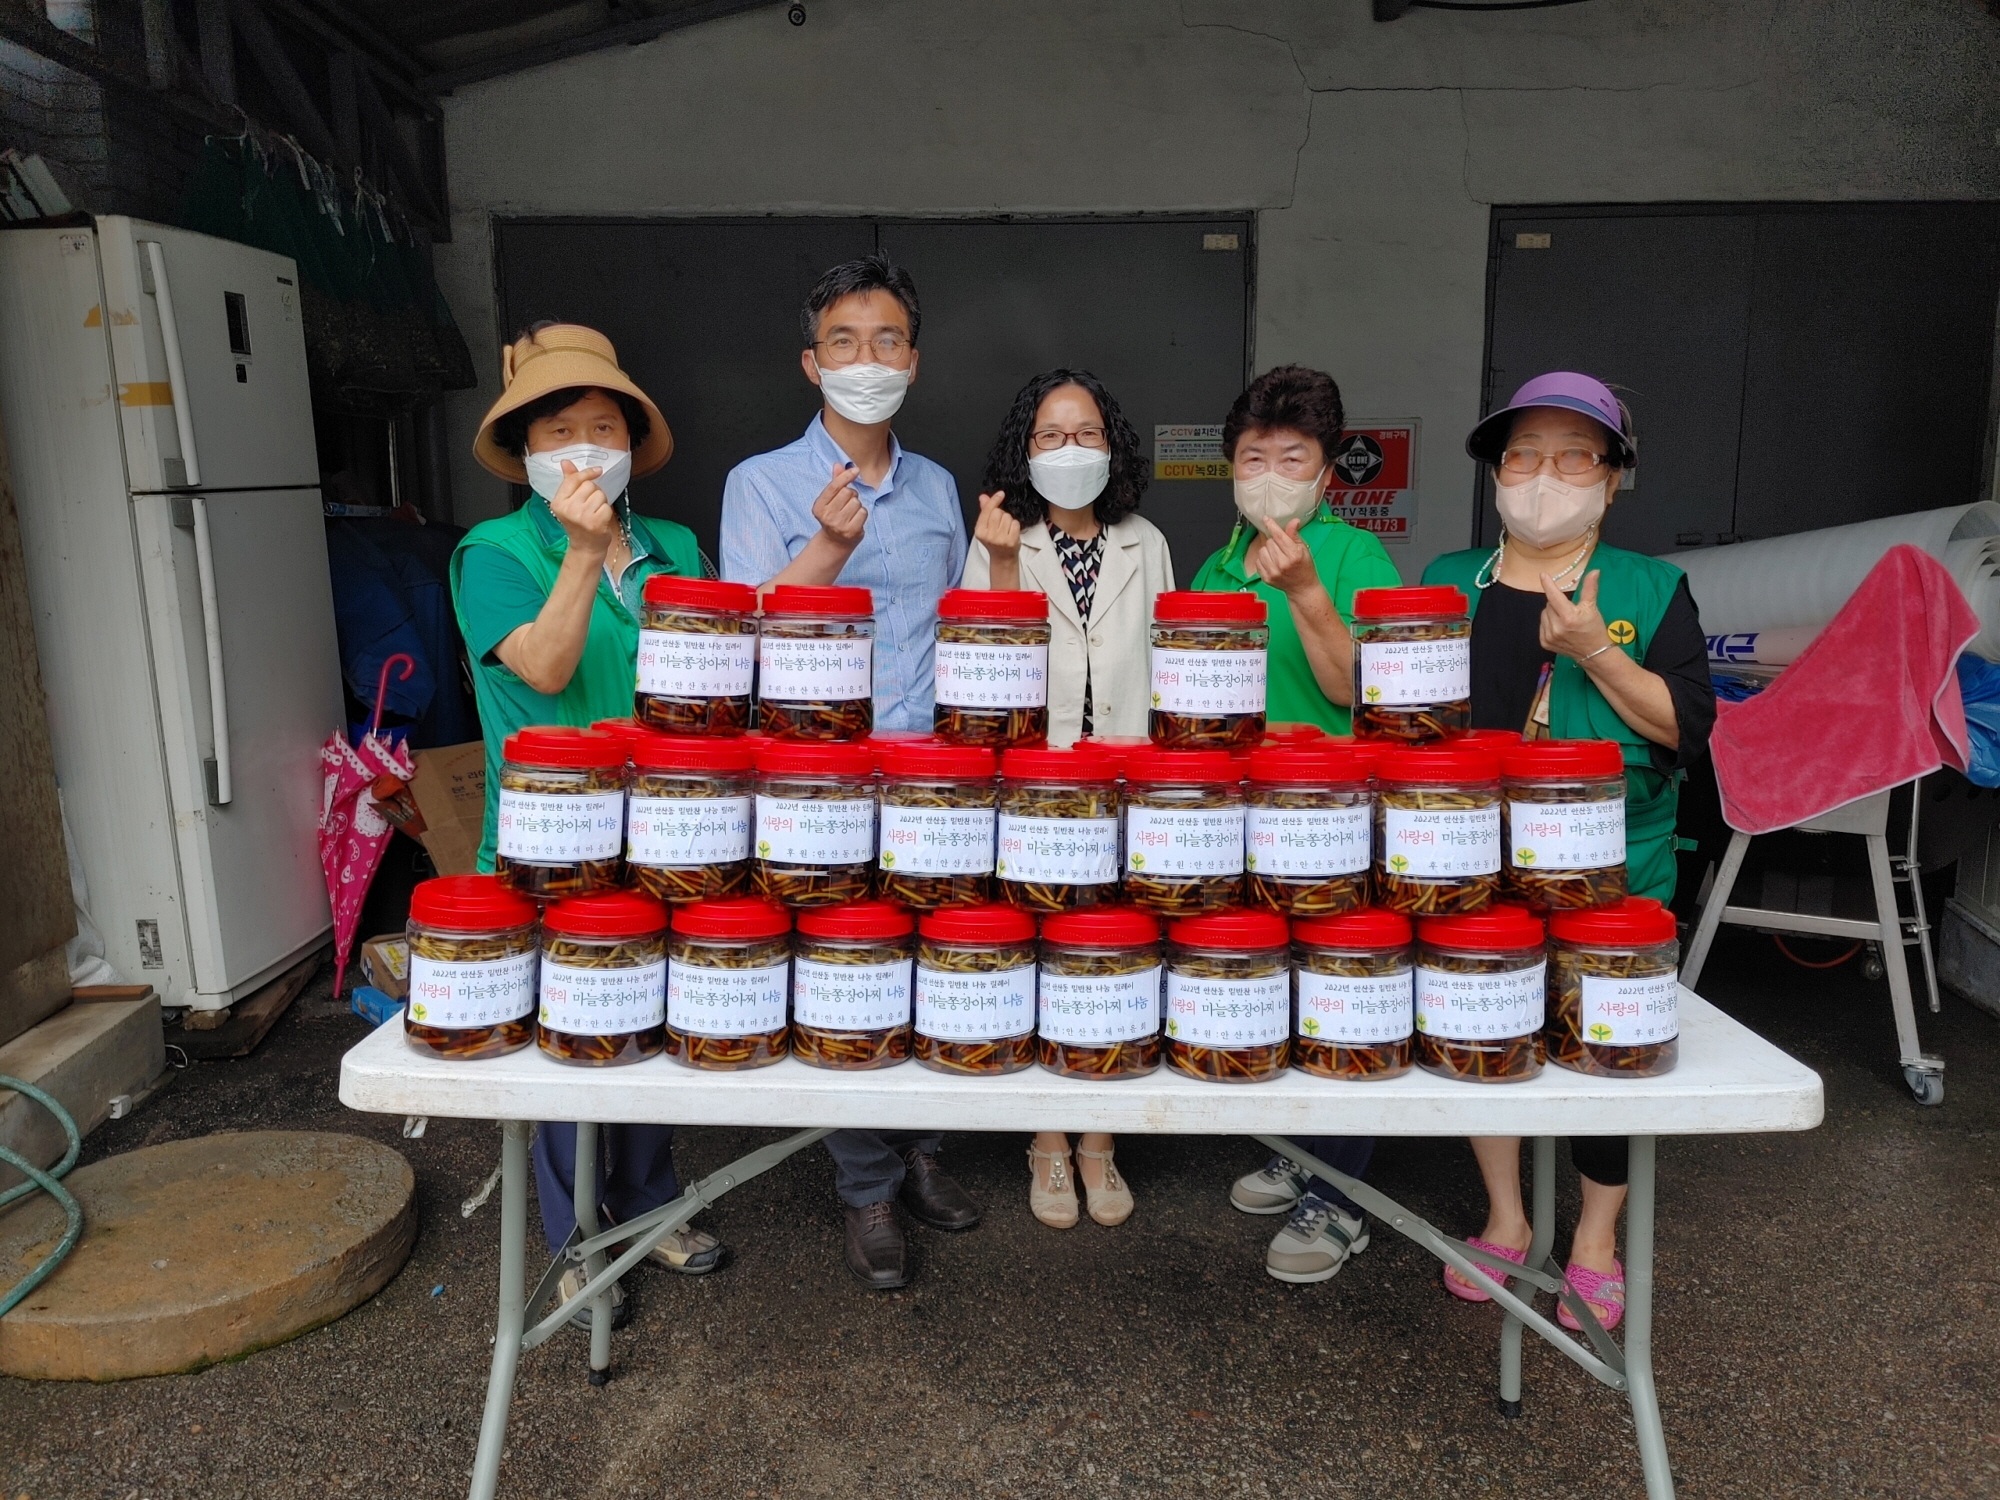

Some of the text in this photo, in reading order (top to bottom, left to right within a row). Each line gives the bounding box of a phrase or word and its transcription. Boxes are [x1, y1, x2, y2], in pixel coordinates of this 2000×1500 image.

[1164, 464, 1229, 477] CCTV녹화중
[1351, 490, 1397, 506] ONE
[1331, 506, 1390, 517] CTV작동중
[660, 654, 750, 670] 마늘쫑장아찌 나눔
[774, 657, 866, 671] 마늘쫑장아찌 나눔
[1370, 661, 1403, 675] 사랑의
[953, 666, 1042, 681] 마늘쫑장아찌 나눔
[1155, 671, 1253, 688] 사랑의 마늘쫑장아찌
[567, 803, 582, 811] 나눔
[705, 806, 718, 815] 나눔
[776, 802, 798, 811] 2022년
[517, 817, 617, 833] 마늘쫑장아찌 나눔
[763, 815, 792, 832] 사랑의
[900, 816, 922, 824] 2022년
[1150, 817, 1174, 825] 2022년
[1414, 815, 1439, 823] 2022년
[653, 821, 747, 837] 마늘쫑장아찌 나눔
[1522, 823, 1561, 838] 사랑의
[887, 829, 916, 845] 사랑의
[1135, 831, 1168, 847] 사랑의
[1281, 830, 1354, 847] 마늘쫑장아찌
[1396, 829, 1433, 845] 사랑의
[1027, 841, 1098, 857] 마늘쫑장아찌
[432, 969, 456, 978] 2022년
[627, 975, 640, 984] 나눔
[733, 977, 747, 985] 나눔
[858, 973, 871, 981] 나눔
[418, 982, 450, 1000] 사랑의
[972, 981, 986, 989] 나눔
[1096, 984, 1110, 992] 나눔
[1254, 987, 1266, 995] 나눔
[1325, 983, 1349, 992] 2022년
[1504, 980, 1518, 988] 나눔
[573, 989, 647, 1007] 마늘쫑장아찌
[684, 989, 781, 1007] 마늘쫑장아찌 나눔
[811, 985, 906, 1003] 마늘쫑장아찌 나눔
[928, 993, 1023, 1011] 마늘쫑장아찌 나눔
[1052, 996, 1148, 1015] 마늘쫑장아찌 나눔
[1171, 997, 1274, 1018] 사랑의 마늘쫑장아찌
[1308, 996, 1343, 1014] 사랑의
[1451, 993, 1528, 1011] 마늘쫑장아찌
[1597, 1002, 1638, 1016] 사랑의
